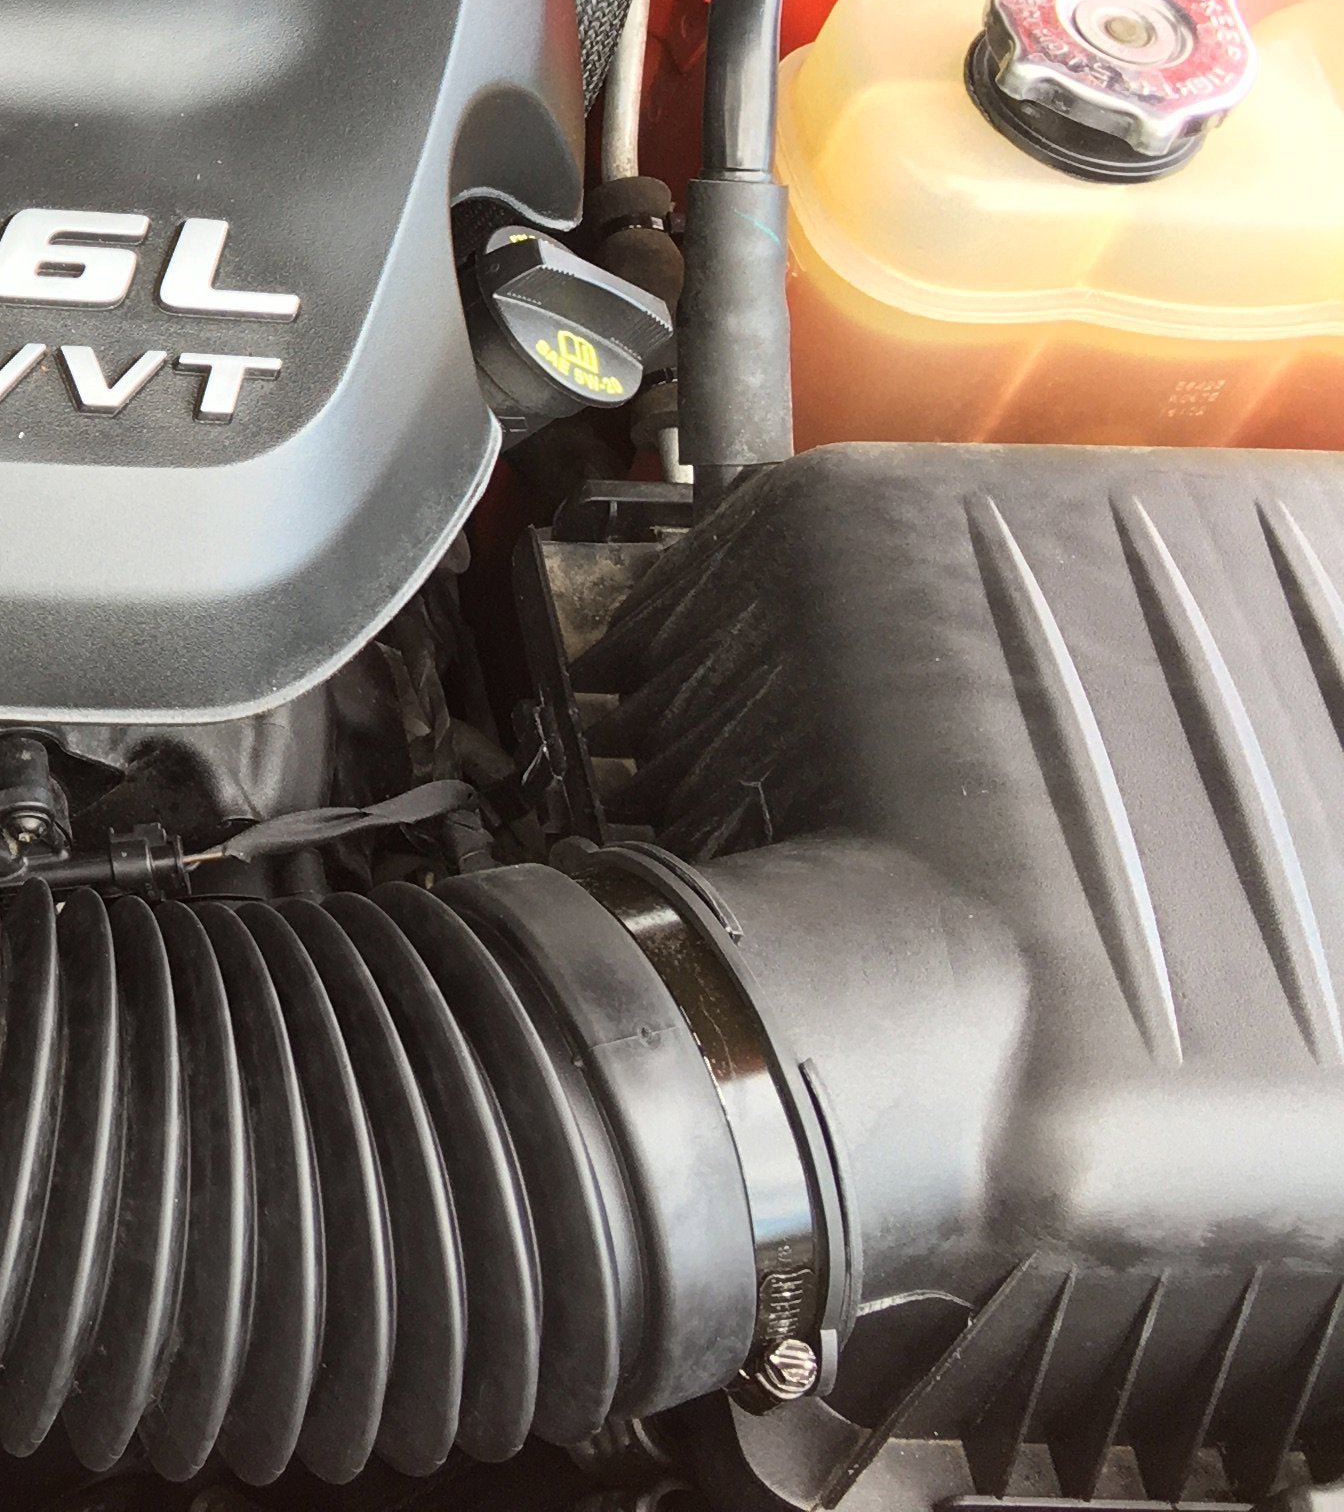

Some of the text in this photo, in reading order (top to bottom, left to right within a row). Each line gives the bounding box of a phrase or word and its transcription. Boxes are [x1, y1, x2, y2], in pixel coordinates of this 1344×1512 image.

[1162, 66, 1234, 101] TIGHT
[535, 339, 624, 395] SAE 5W-20
